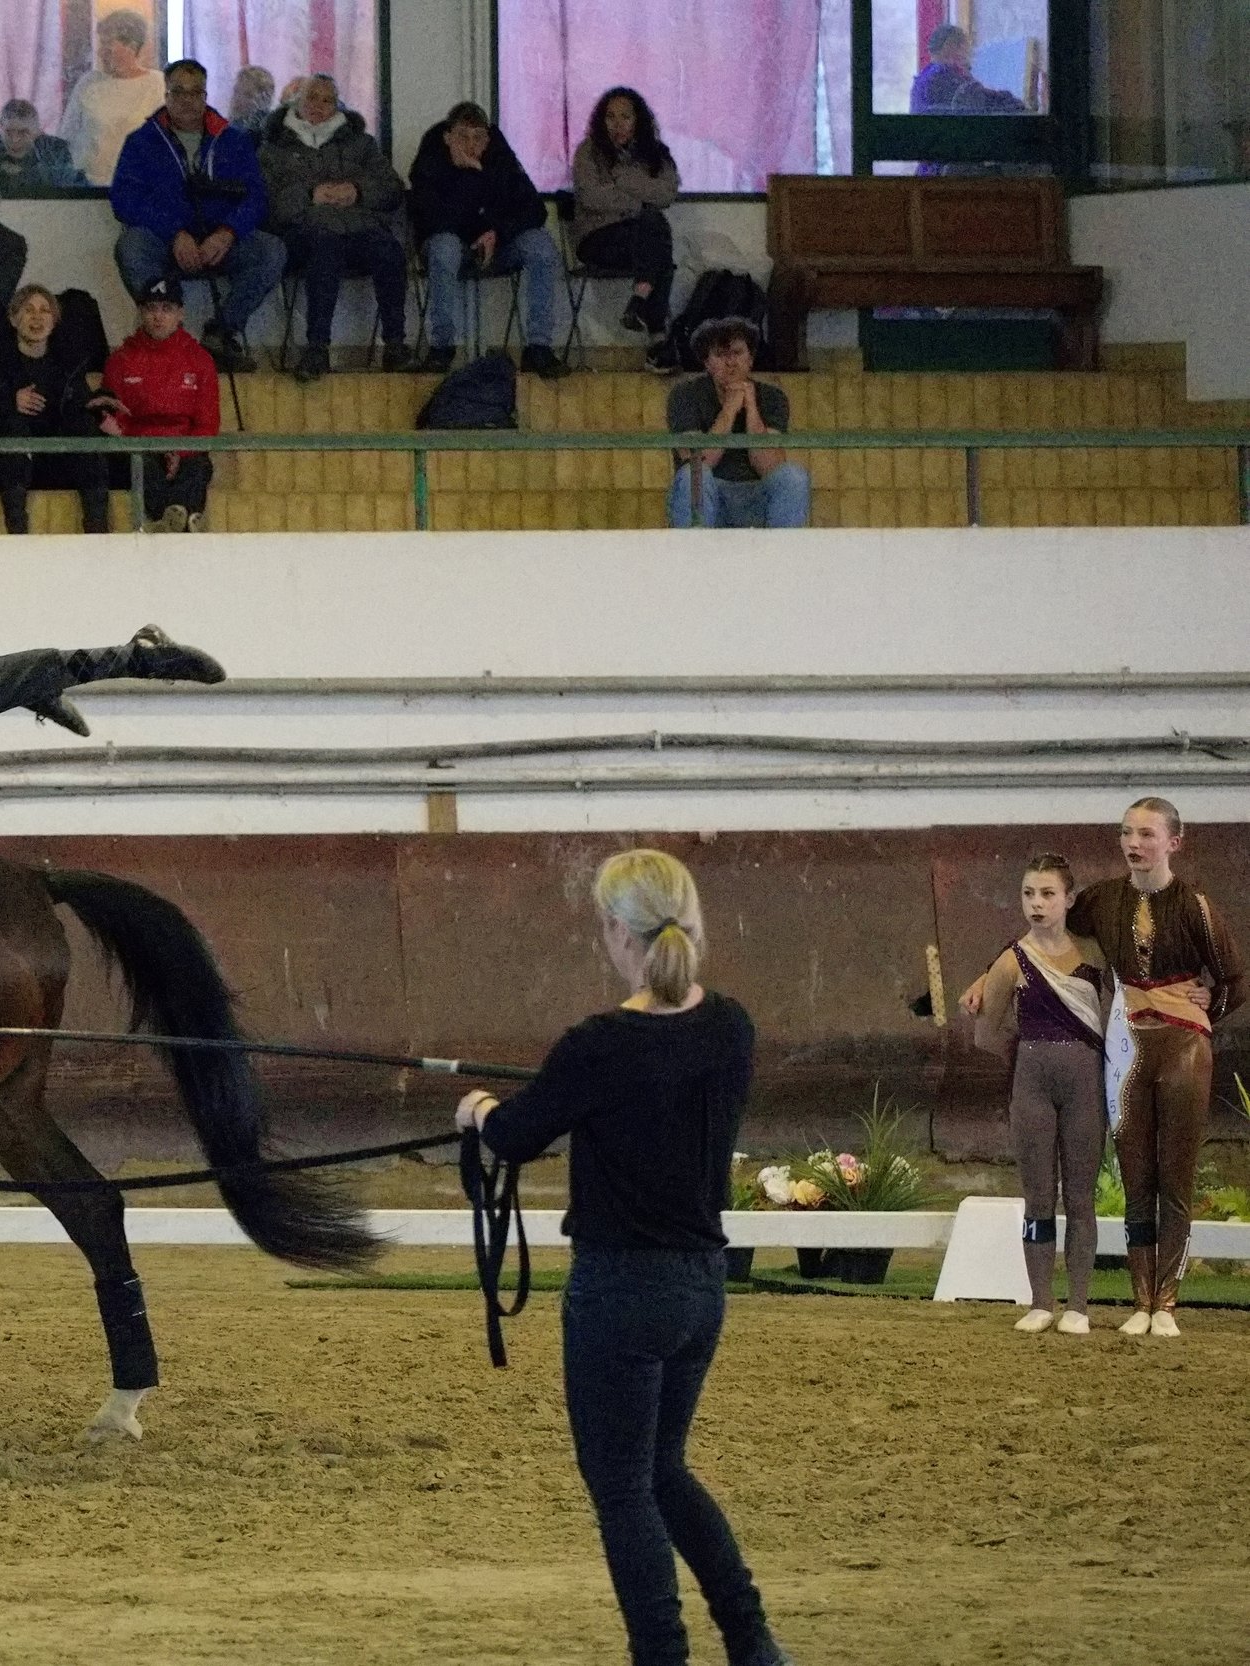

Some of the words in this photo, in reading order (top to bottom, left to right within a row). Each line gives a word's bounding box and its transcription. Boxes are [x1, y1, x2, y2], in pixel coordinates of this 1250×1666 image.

[1114, 1008, 1121, 1020] 2
[1121, 1037, 1129, 1053] 3
[1113, 1067, 1121, 1083] 4
[1109, 1099, 1117, 1114] 5
